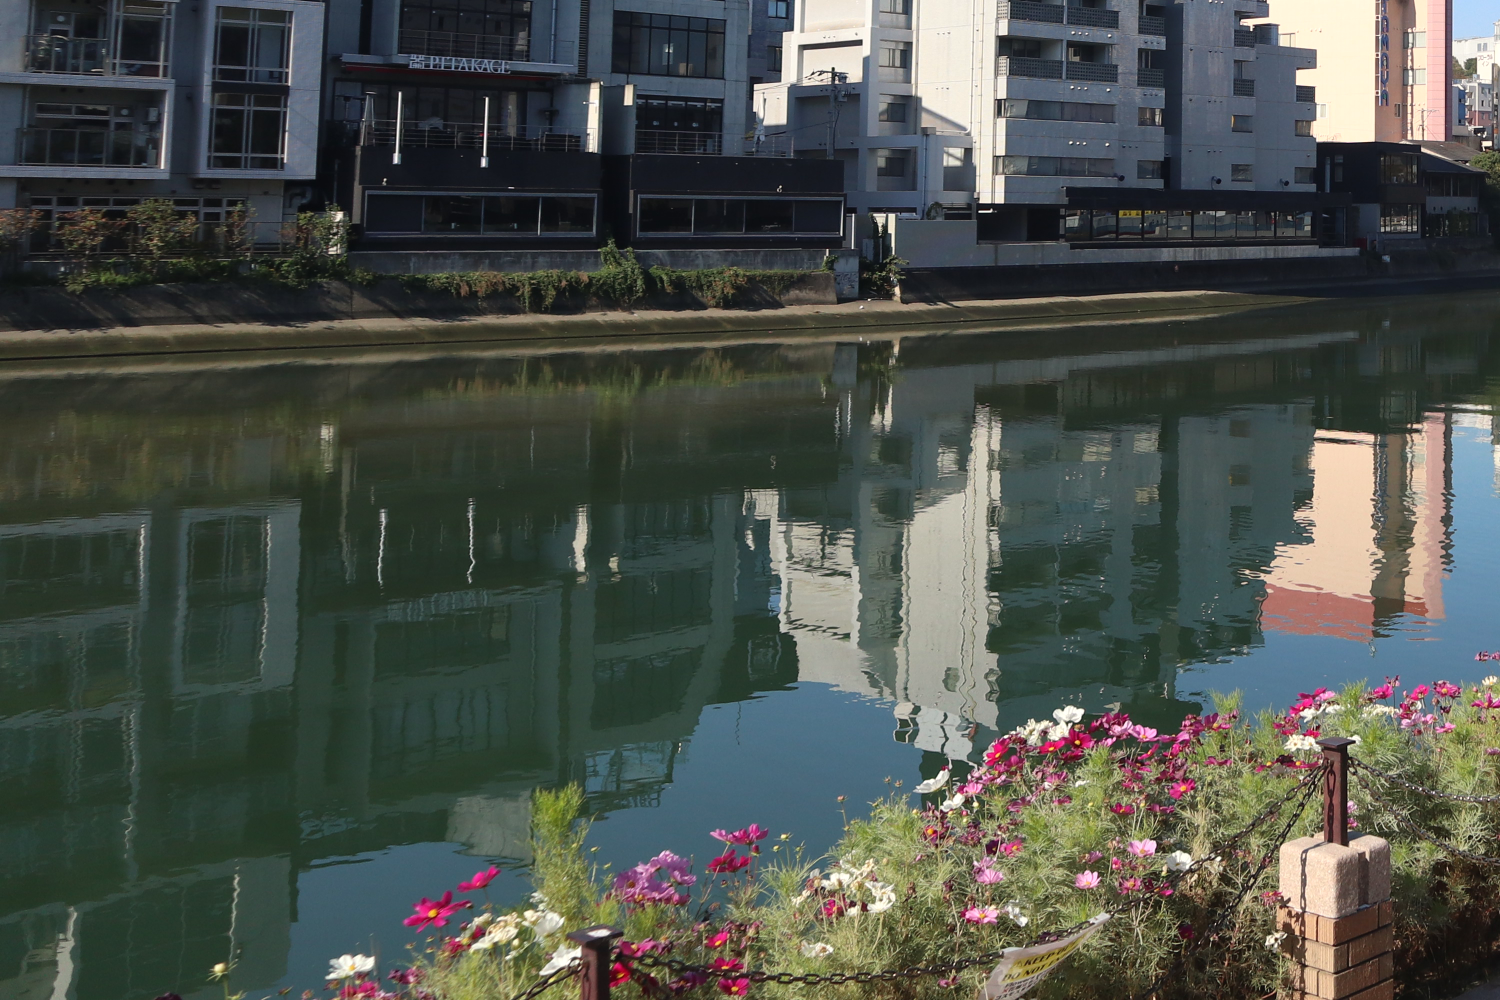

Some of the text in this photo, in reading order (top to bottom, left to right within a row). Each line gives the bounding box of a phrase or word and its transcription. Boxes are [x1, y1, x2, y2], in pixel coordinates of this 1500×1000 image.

[1024, 953, 1055, 966] KEEP
[1002, 965, 1046, 982] DO NOT
